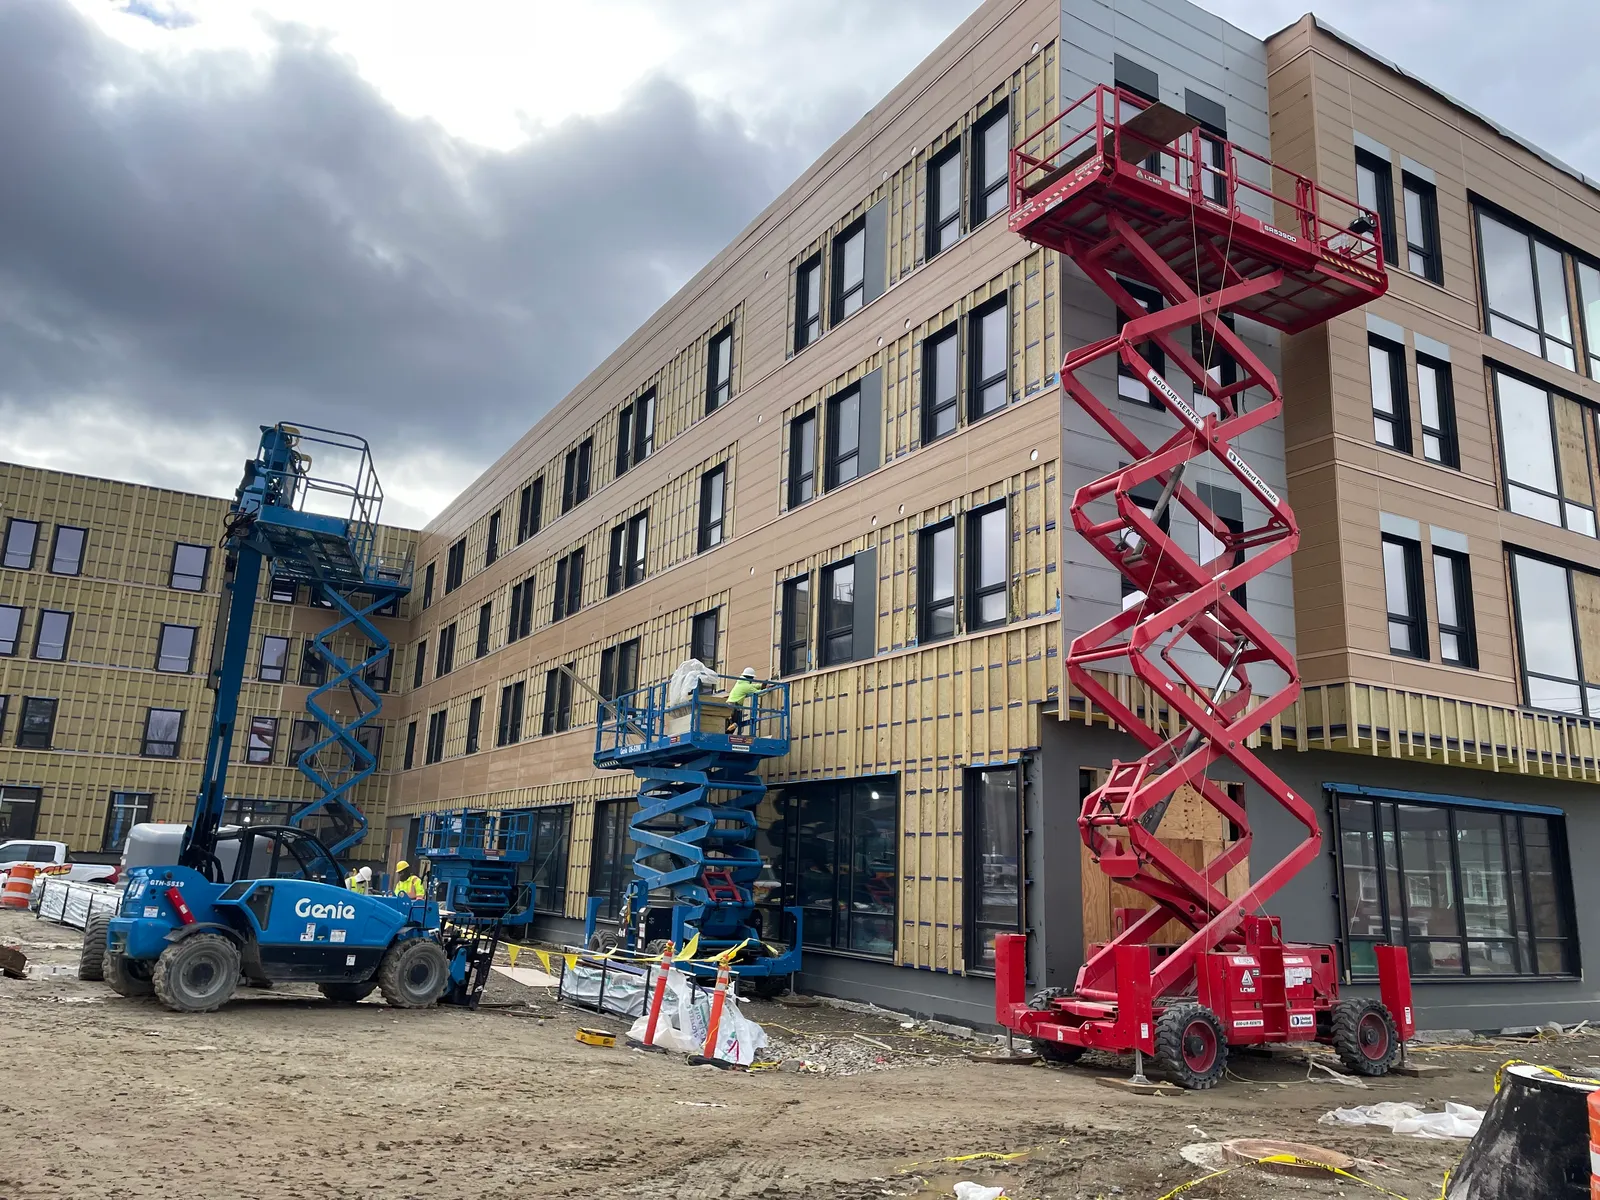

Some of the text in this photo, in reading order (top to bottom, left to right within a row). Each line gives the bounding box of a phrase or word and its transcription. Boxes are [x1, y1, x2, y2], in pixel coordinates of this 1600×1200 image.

[1152, 375, 1201, 425] 800-UR-RENTS
[1236, 460, 1277, 503] United Rentals
[149, 879, 185, 888] GTH-5519
[295, 897, 356, 920] Genie
